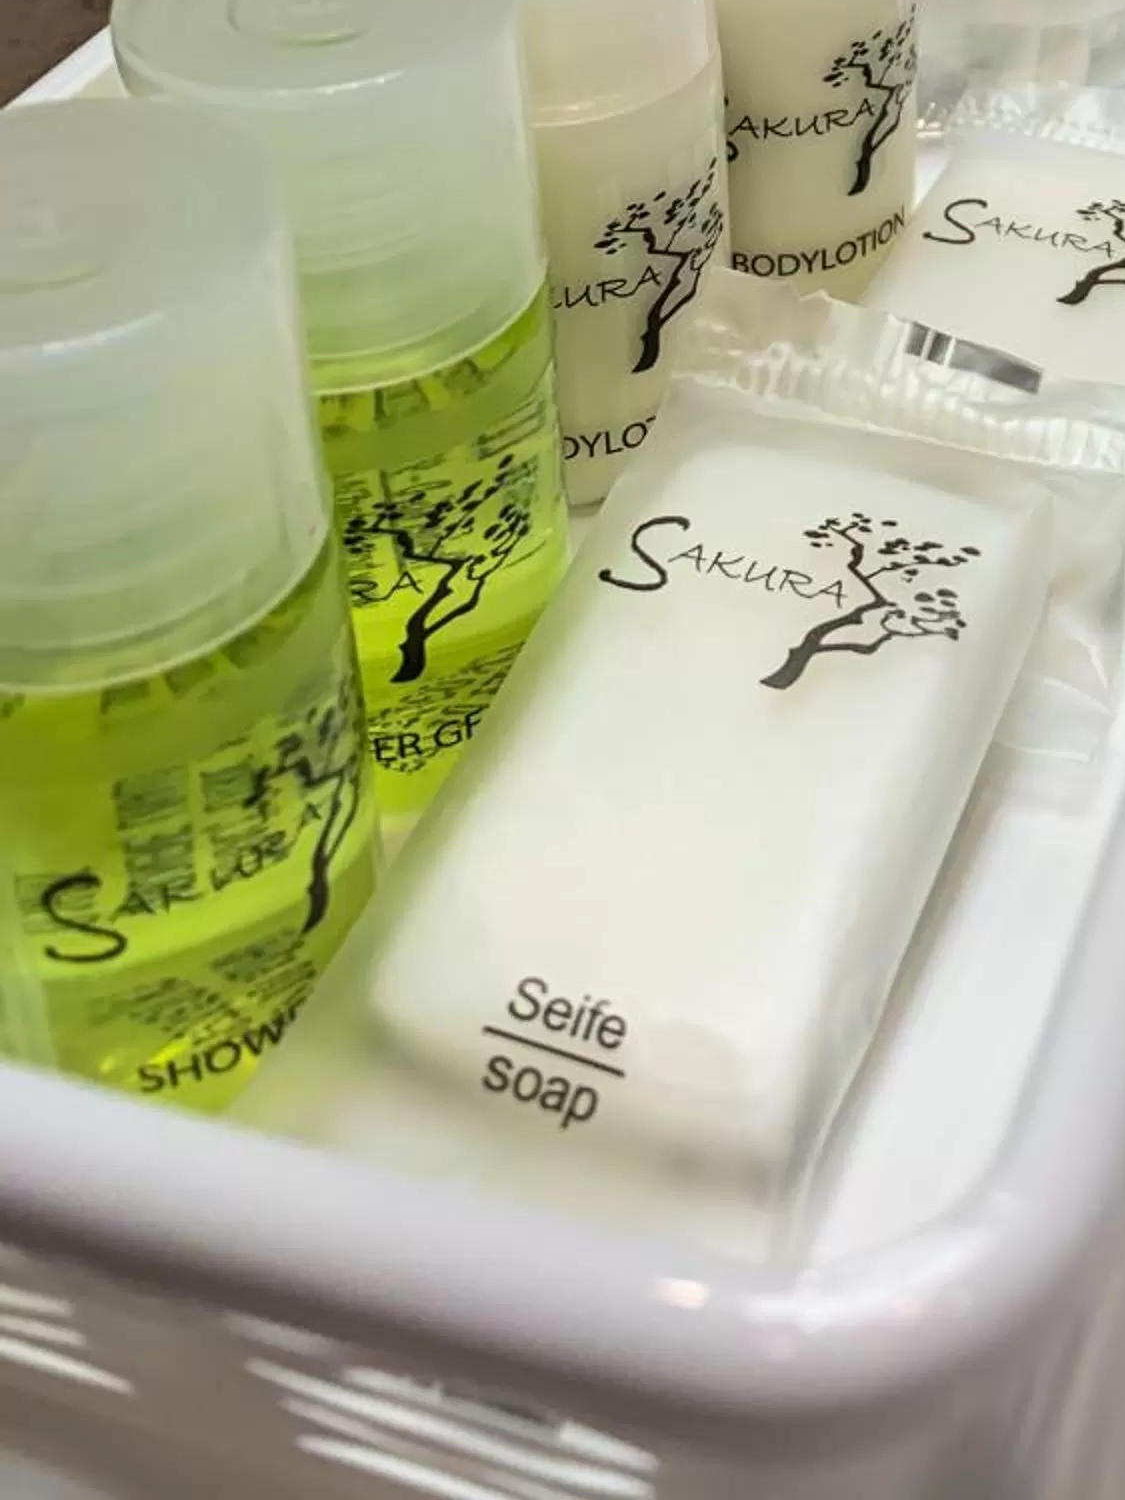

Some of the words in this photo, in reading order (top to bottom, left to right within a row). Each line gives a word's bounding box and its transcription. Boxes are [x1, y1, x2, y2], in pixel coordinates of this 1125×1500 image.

[725, 97, 876, 163] AKURA
[731, 204, 905, 277] BODYLOTION
[923, 199, 1115, 260] SAKURA
[554, 264, 663, 309] URA
[563, 415, 657, 460] DYLO
[599, 515, 848, 608] SAKURA
[507, 976, 627, 1050] Seife
[482, 1055, 600, 1130] soap
